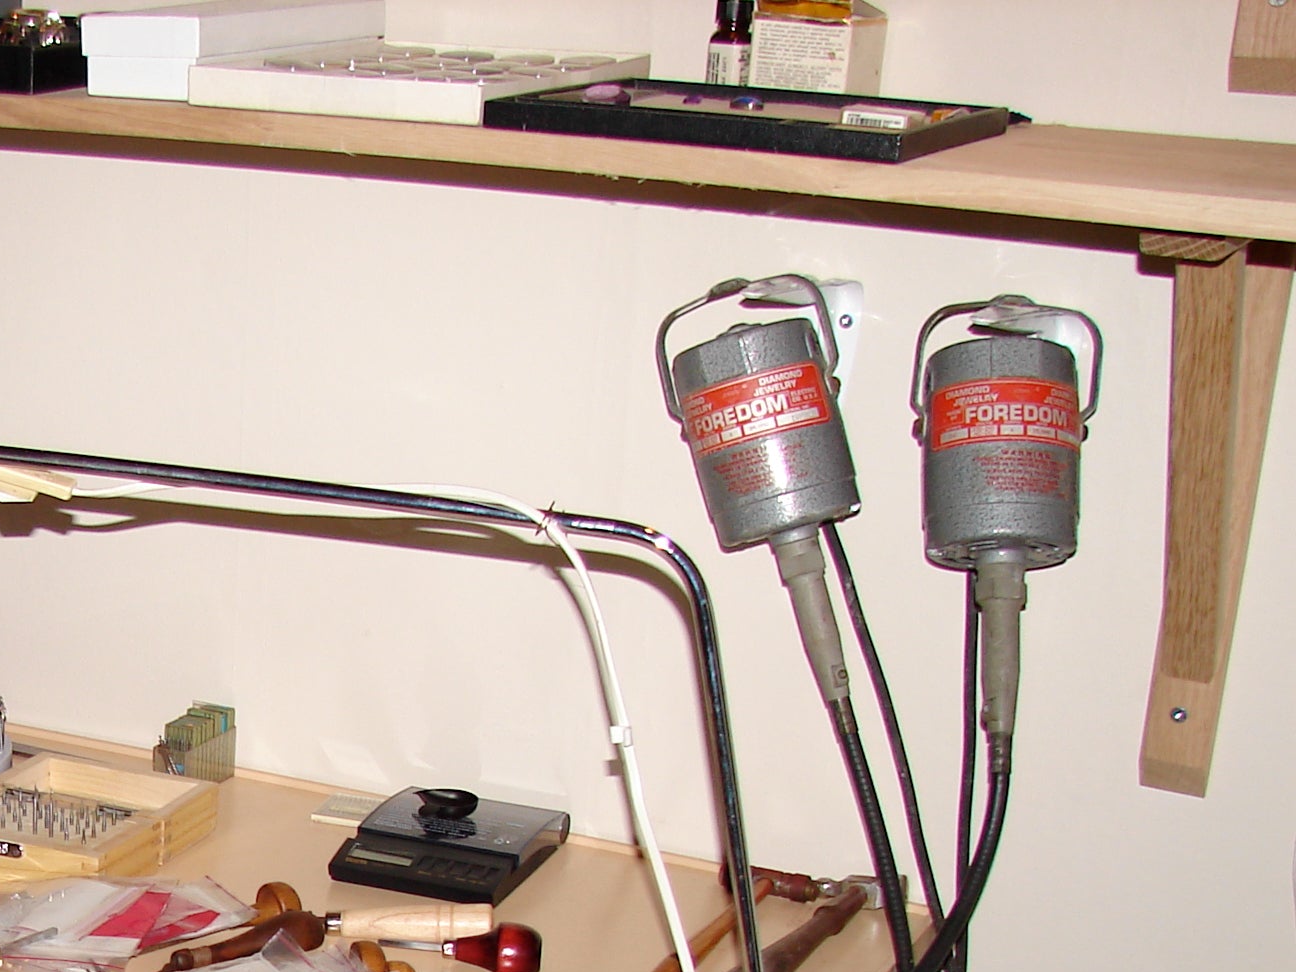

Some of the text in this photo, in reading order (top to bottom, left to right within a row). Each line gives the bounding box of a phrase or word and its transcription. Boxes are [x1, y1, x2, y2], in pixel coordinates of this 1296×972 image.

[758, 369, 803, 386] DIAMOND
[754, 379, 797, 397] JEWELRY
[945, 385, 991, 400] DIAMOND
[953, 393, 1000, 407] JEWELRY
[694, 394, 789, 436] FOREDOM
[965, 404, 1068, 427] FOREDOM
